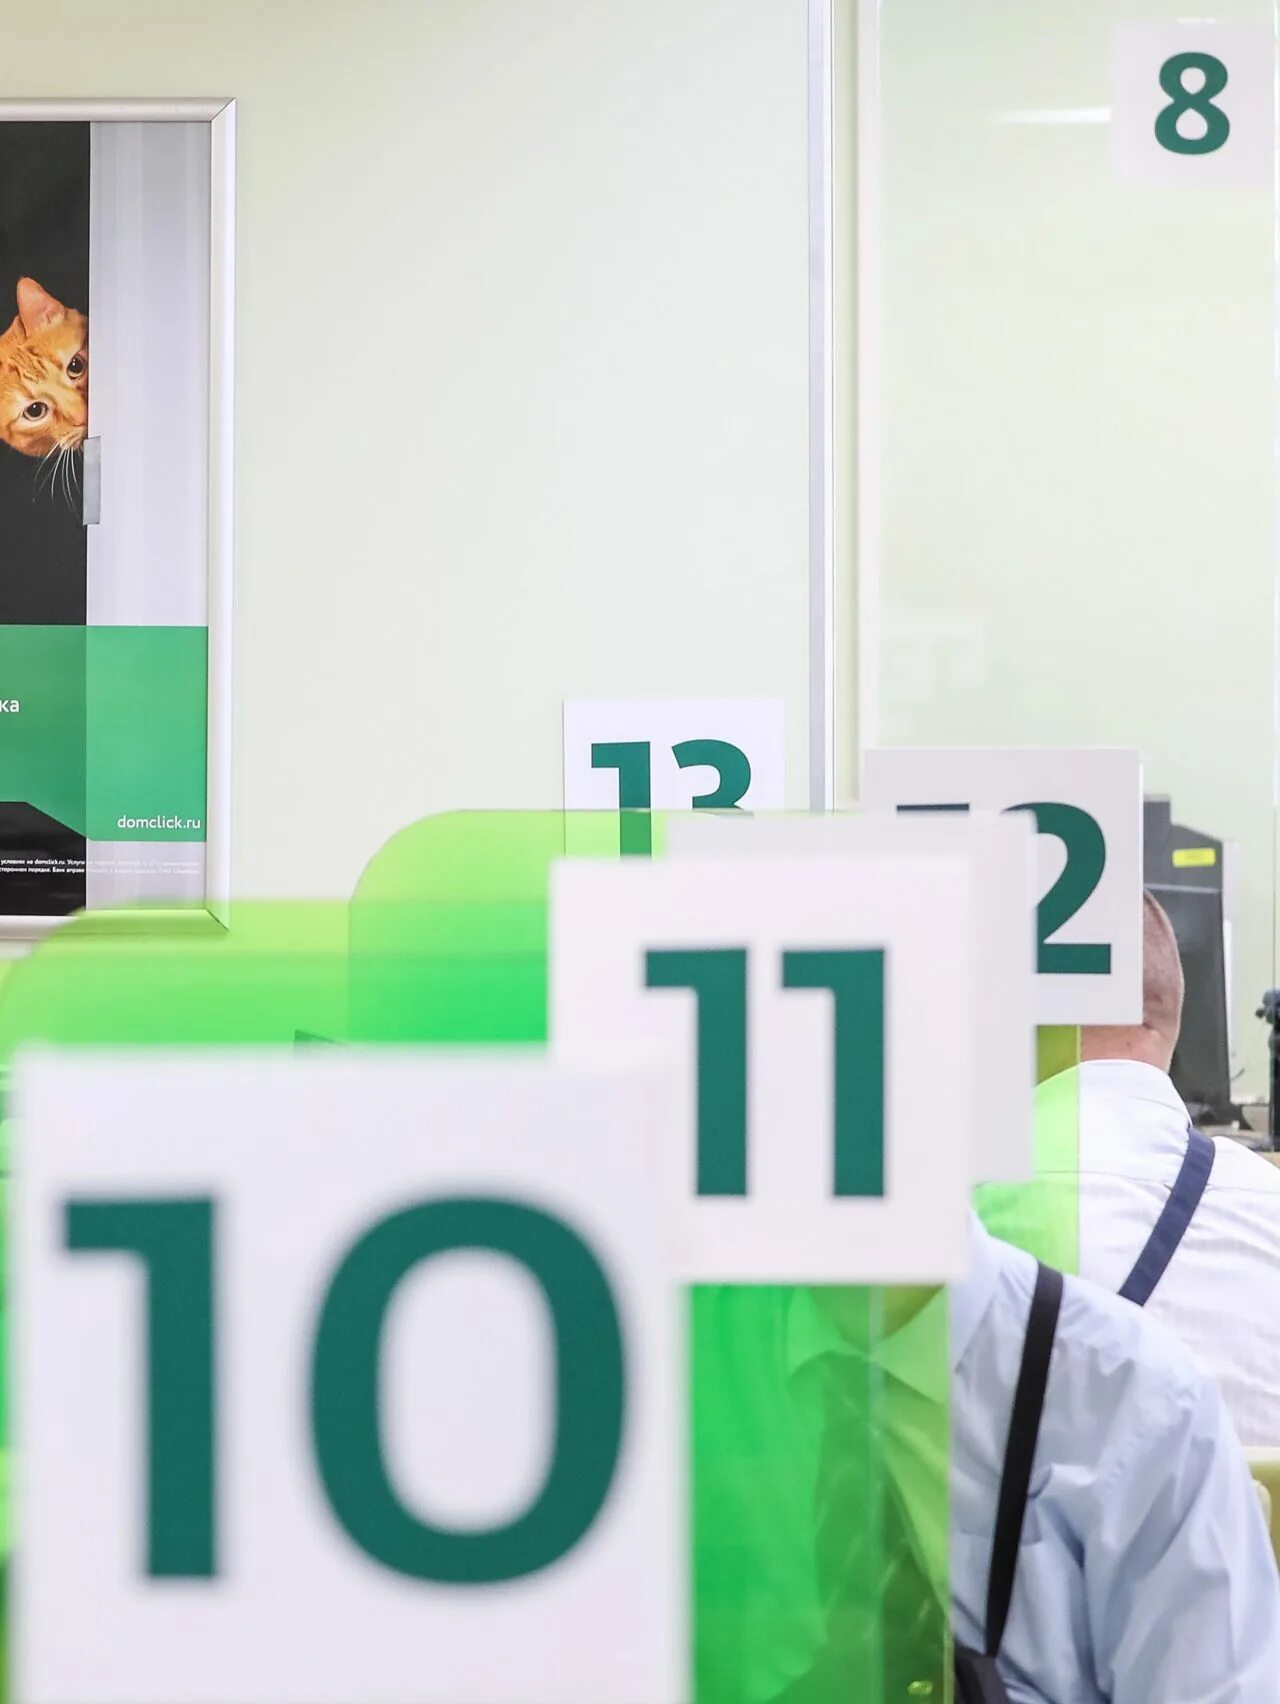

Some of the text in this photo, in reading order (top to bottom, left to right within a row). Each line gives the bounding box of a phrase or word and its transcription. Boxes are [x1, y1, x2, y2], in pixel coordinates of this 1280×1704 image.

[1154, 52, 1230, 155] 8
[117, 815, 201, 829] domclick.ru
[897, 802, 1112, 974] 2
[645, 946, 885, 1197] 11
[64, 1195, 627, 1584] 10
